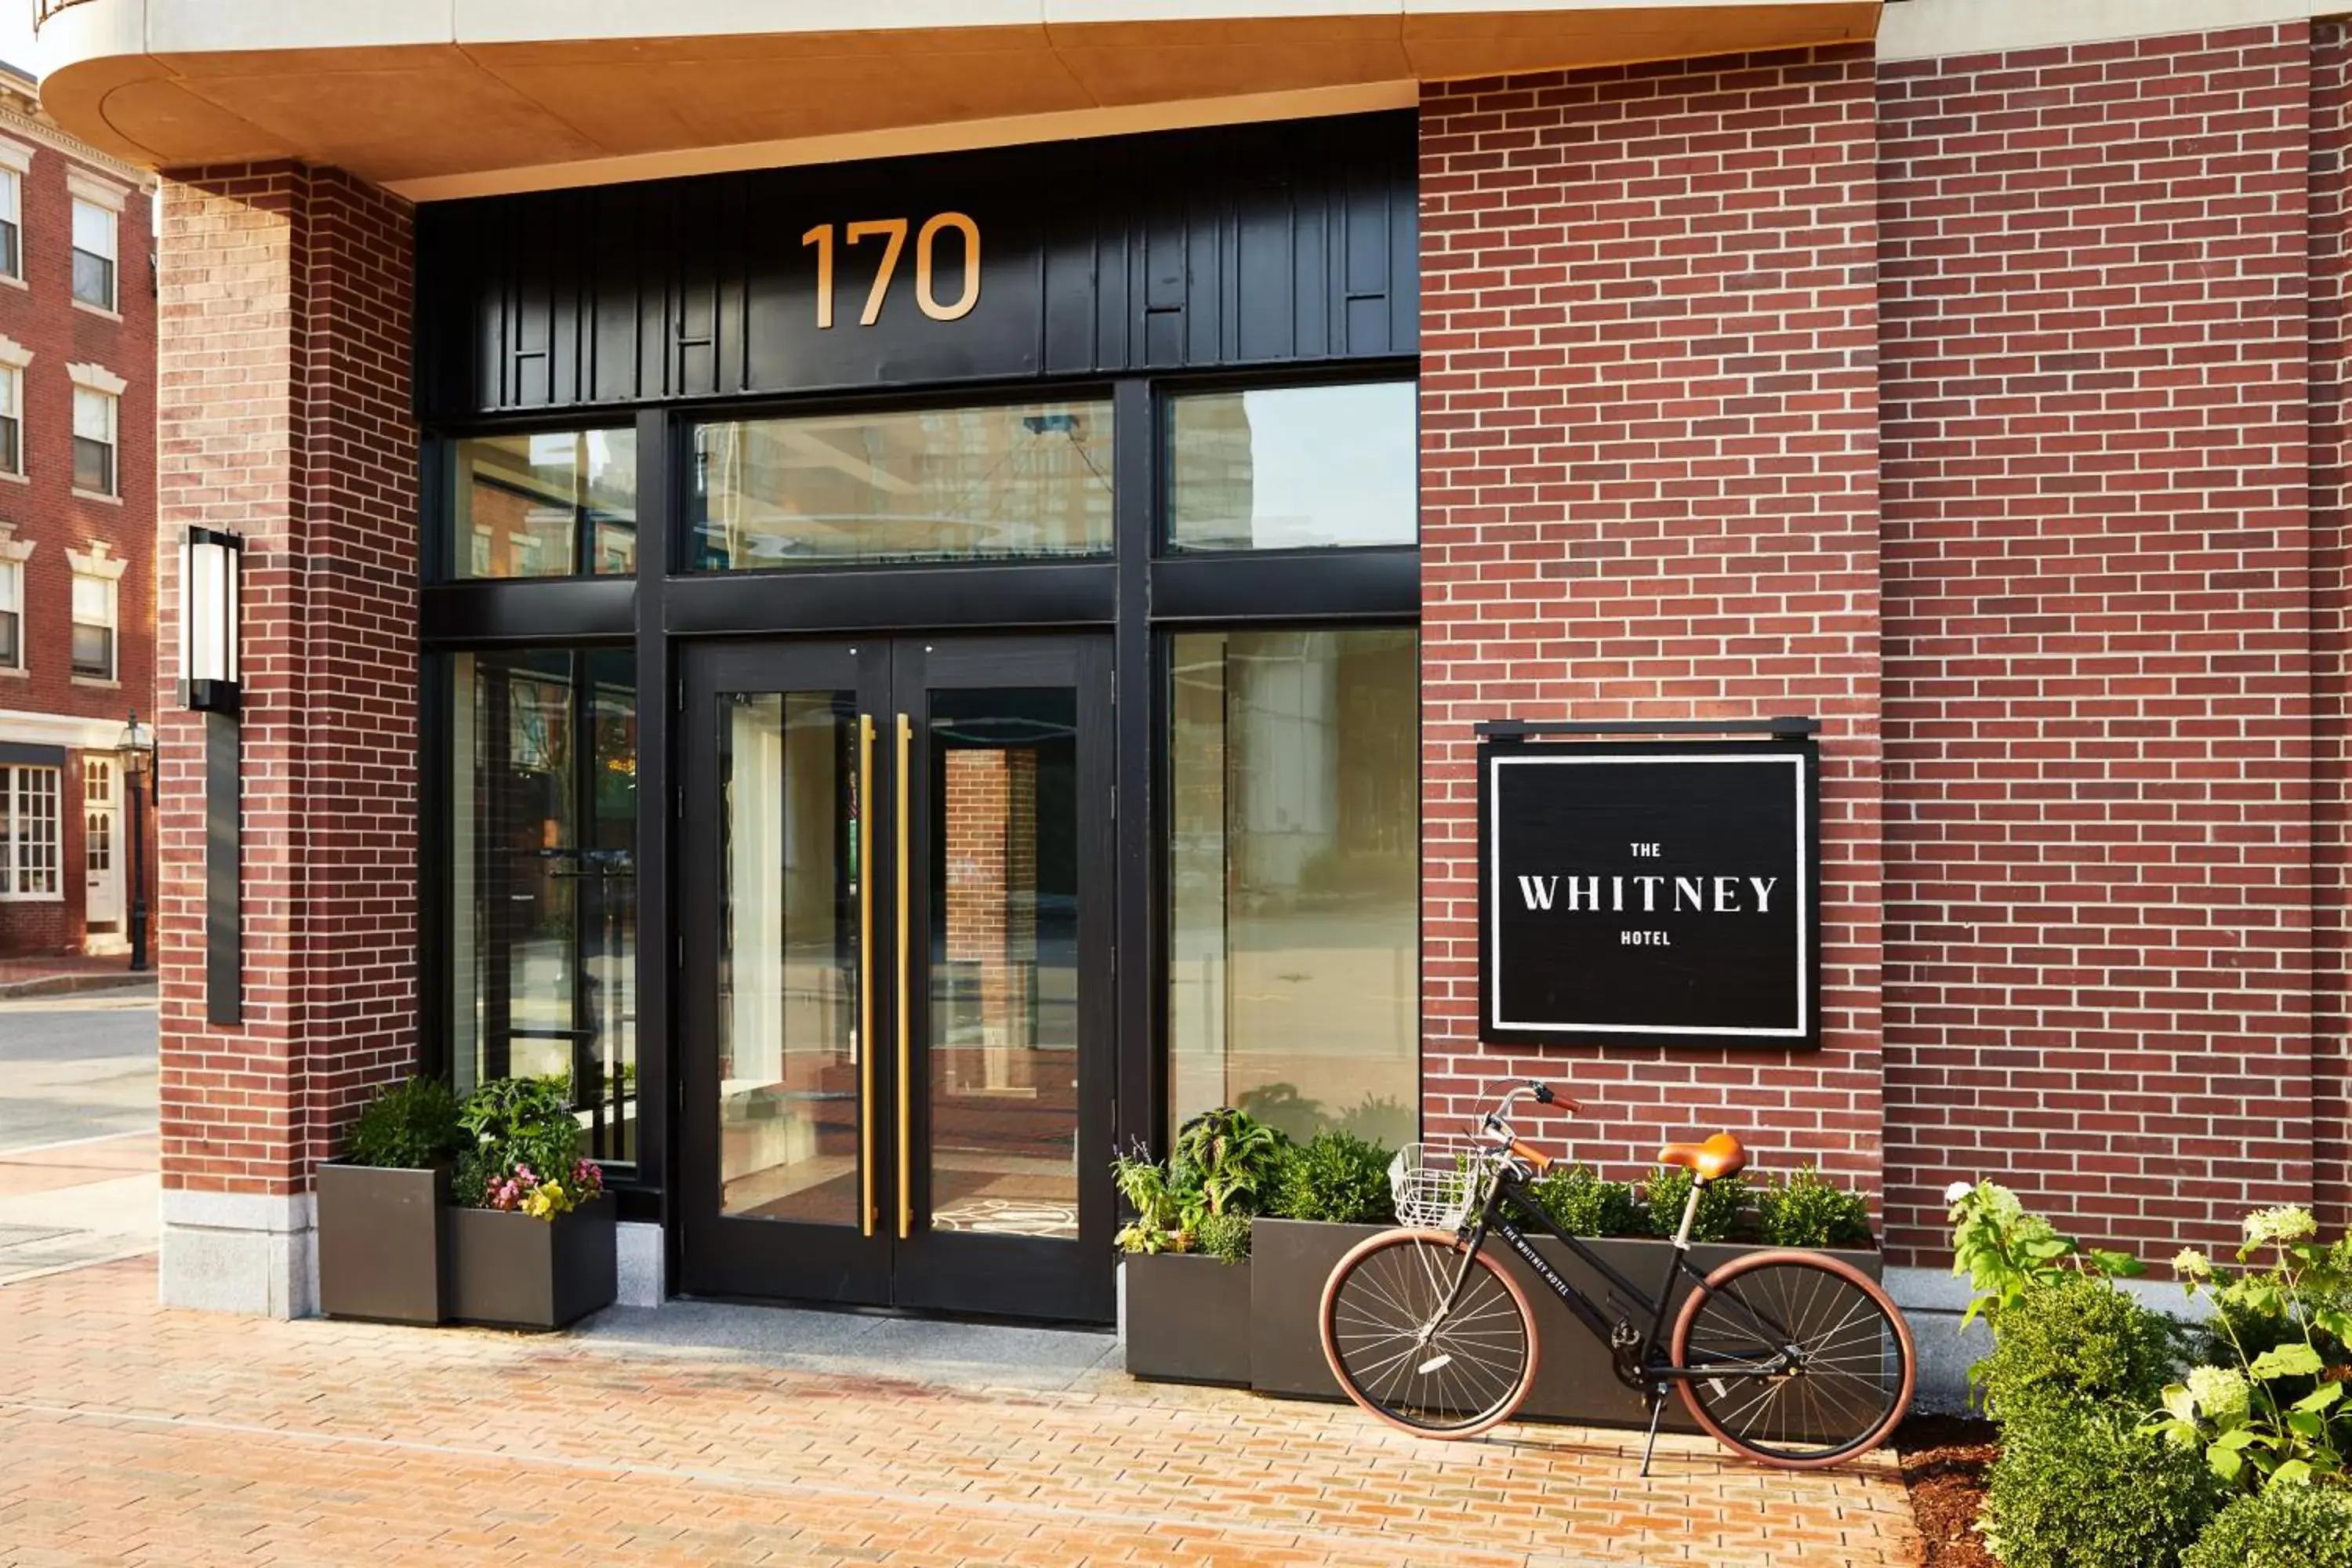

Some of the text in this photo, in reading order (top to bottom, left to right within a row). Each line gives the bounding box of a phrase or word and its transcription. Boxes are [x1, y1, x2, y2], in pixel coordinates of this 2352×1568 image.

[802, 211, 981, 328] 170
[1630, 843, 1661, 857] THE
[1518, 875, 1777, 912] WHITNEY
[1621, 931, 1671, 945] HOTEL
[1504, 1225, 1569, 1296] THE WHITNEY HOTEL
